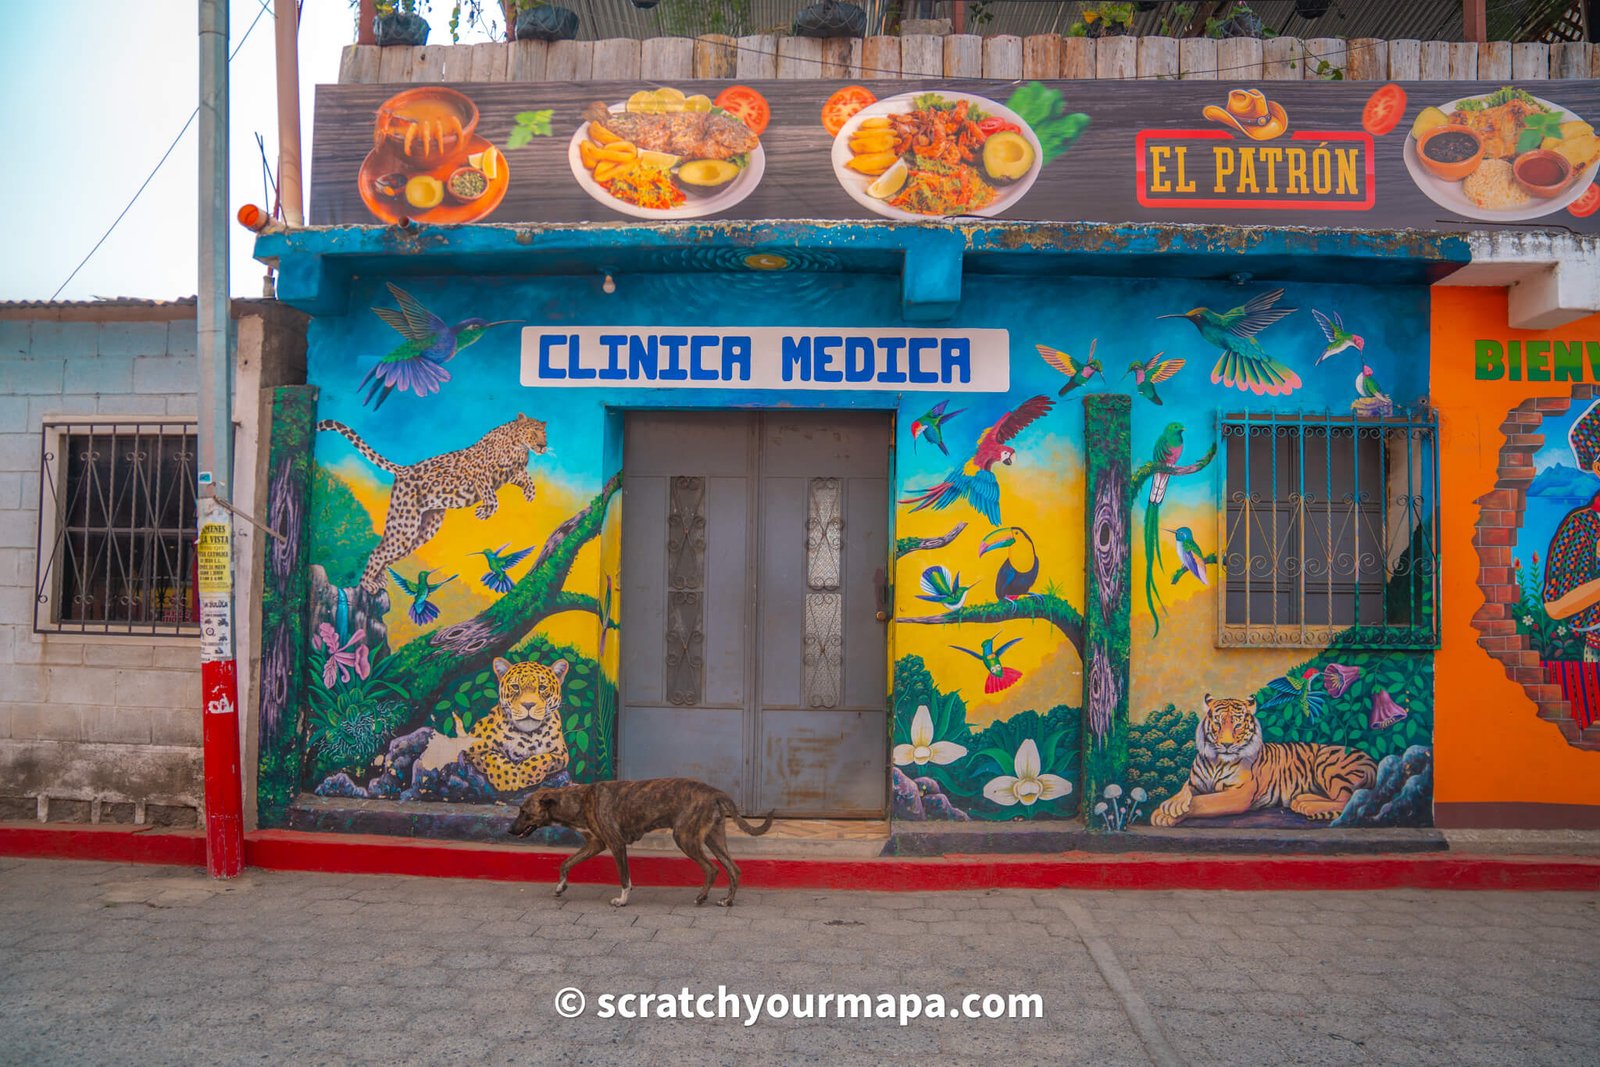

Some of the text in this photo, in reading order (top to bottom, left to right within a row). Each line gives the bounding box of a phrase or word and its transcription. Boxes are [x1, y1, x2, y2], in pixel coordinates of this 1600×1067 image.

[1150, 141, 1359, 195] EL PATRÓN
[538, 334, 971, 384] CLINICA MEDICA
